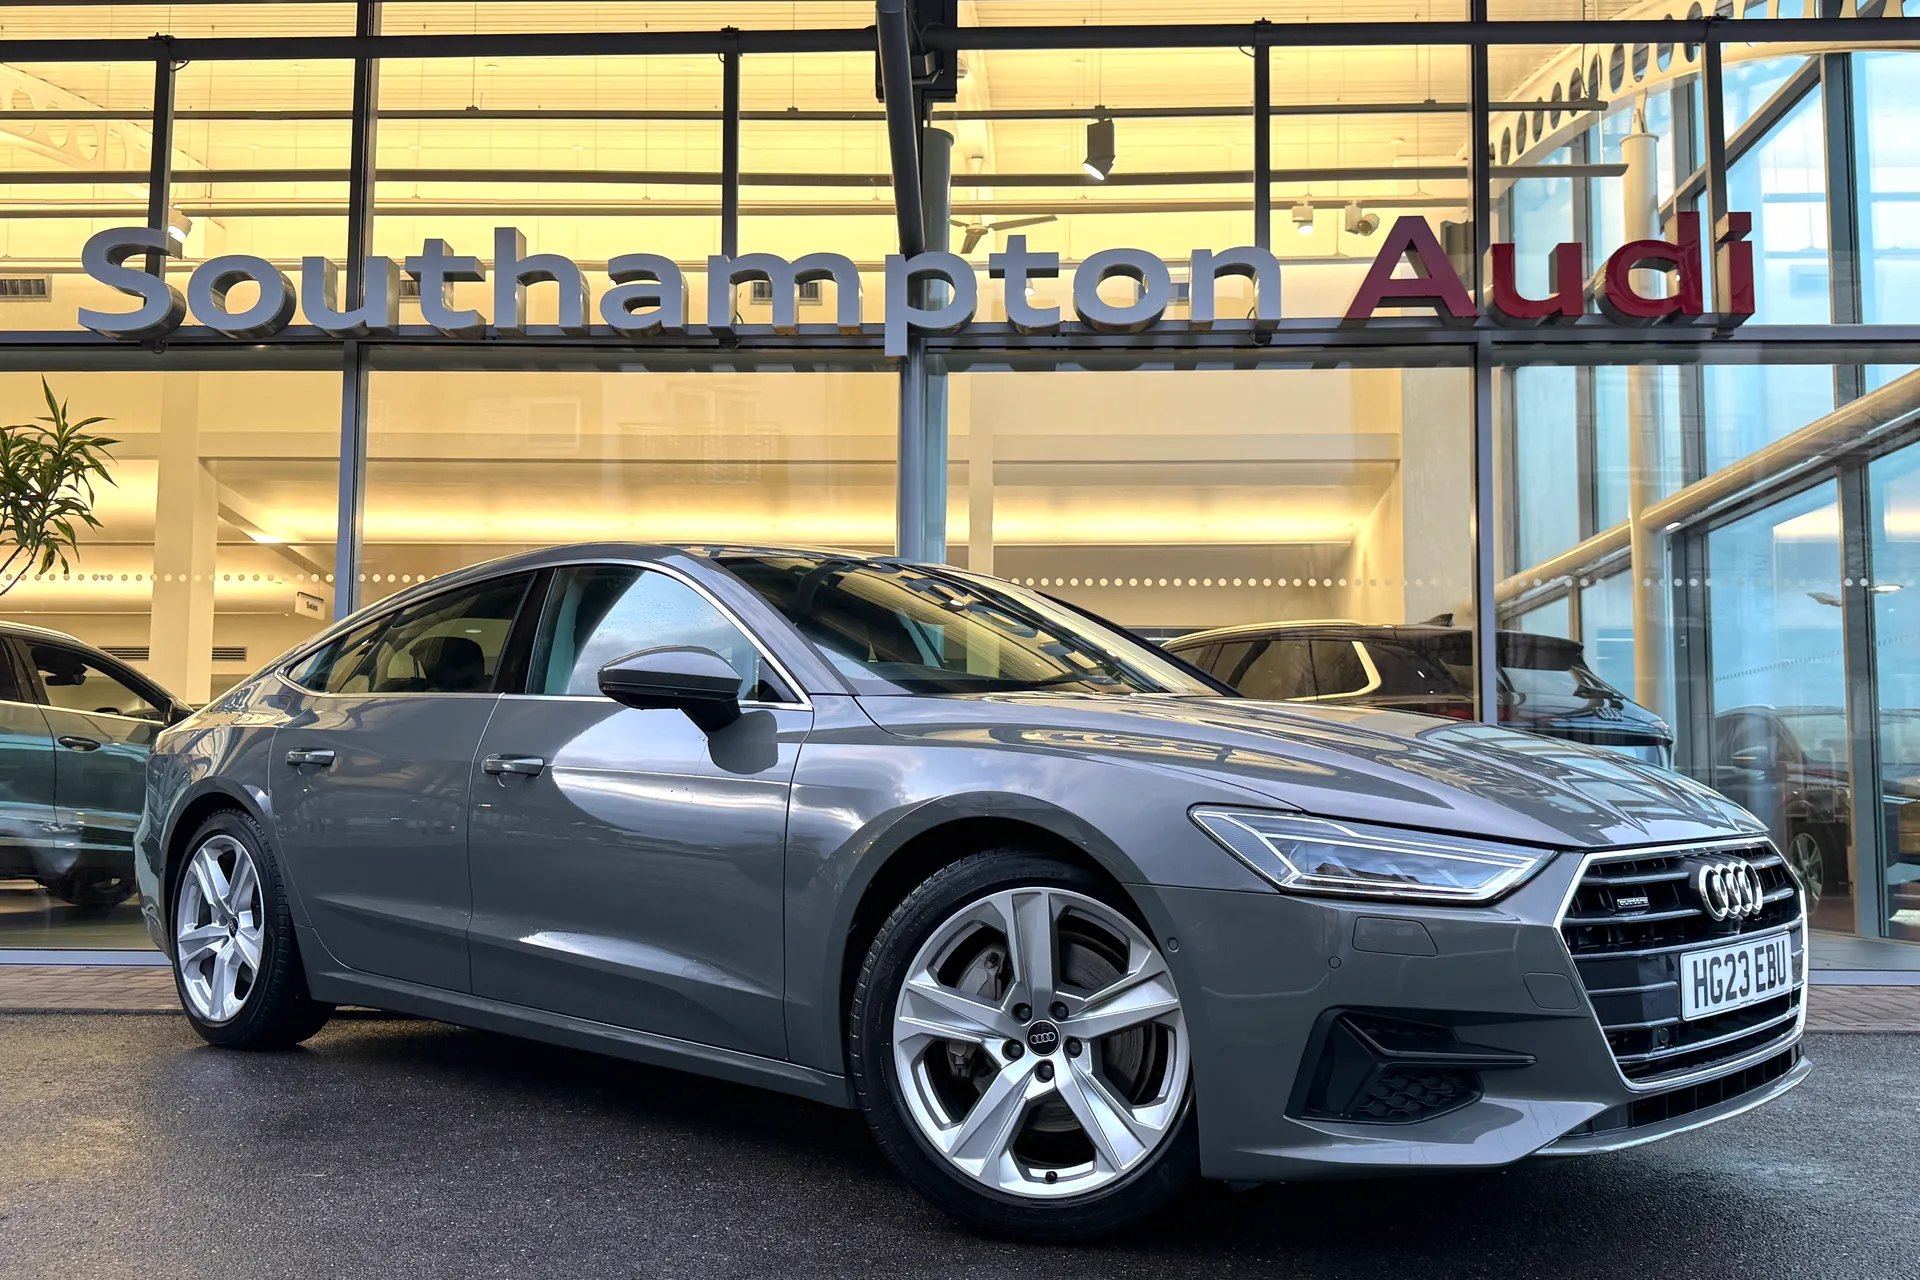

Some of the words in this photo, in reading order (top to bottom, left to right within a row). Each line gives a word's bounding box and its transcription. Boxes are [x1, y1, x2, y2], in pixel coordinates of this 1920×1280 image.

[78, 227, 1282, 358] Southampton
[1343, 211, 1756, 322] Audi
[1693, 950, 1750, 1009] HG23
[1754, 940, 1787, 993] EBU
